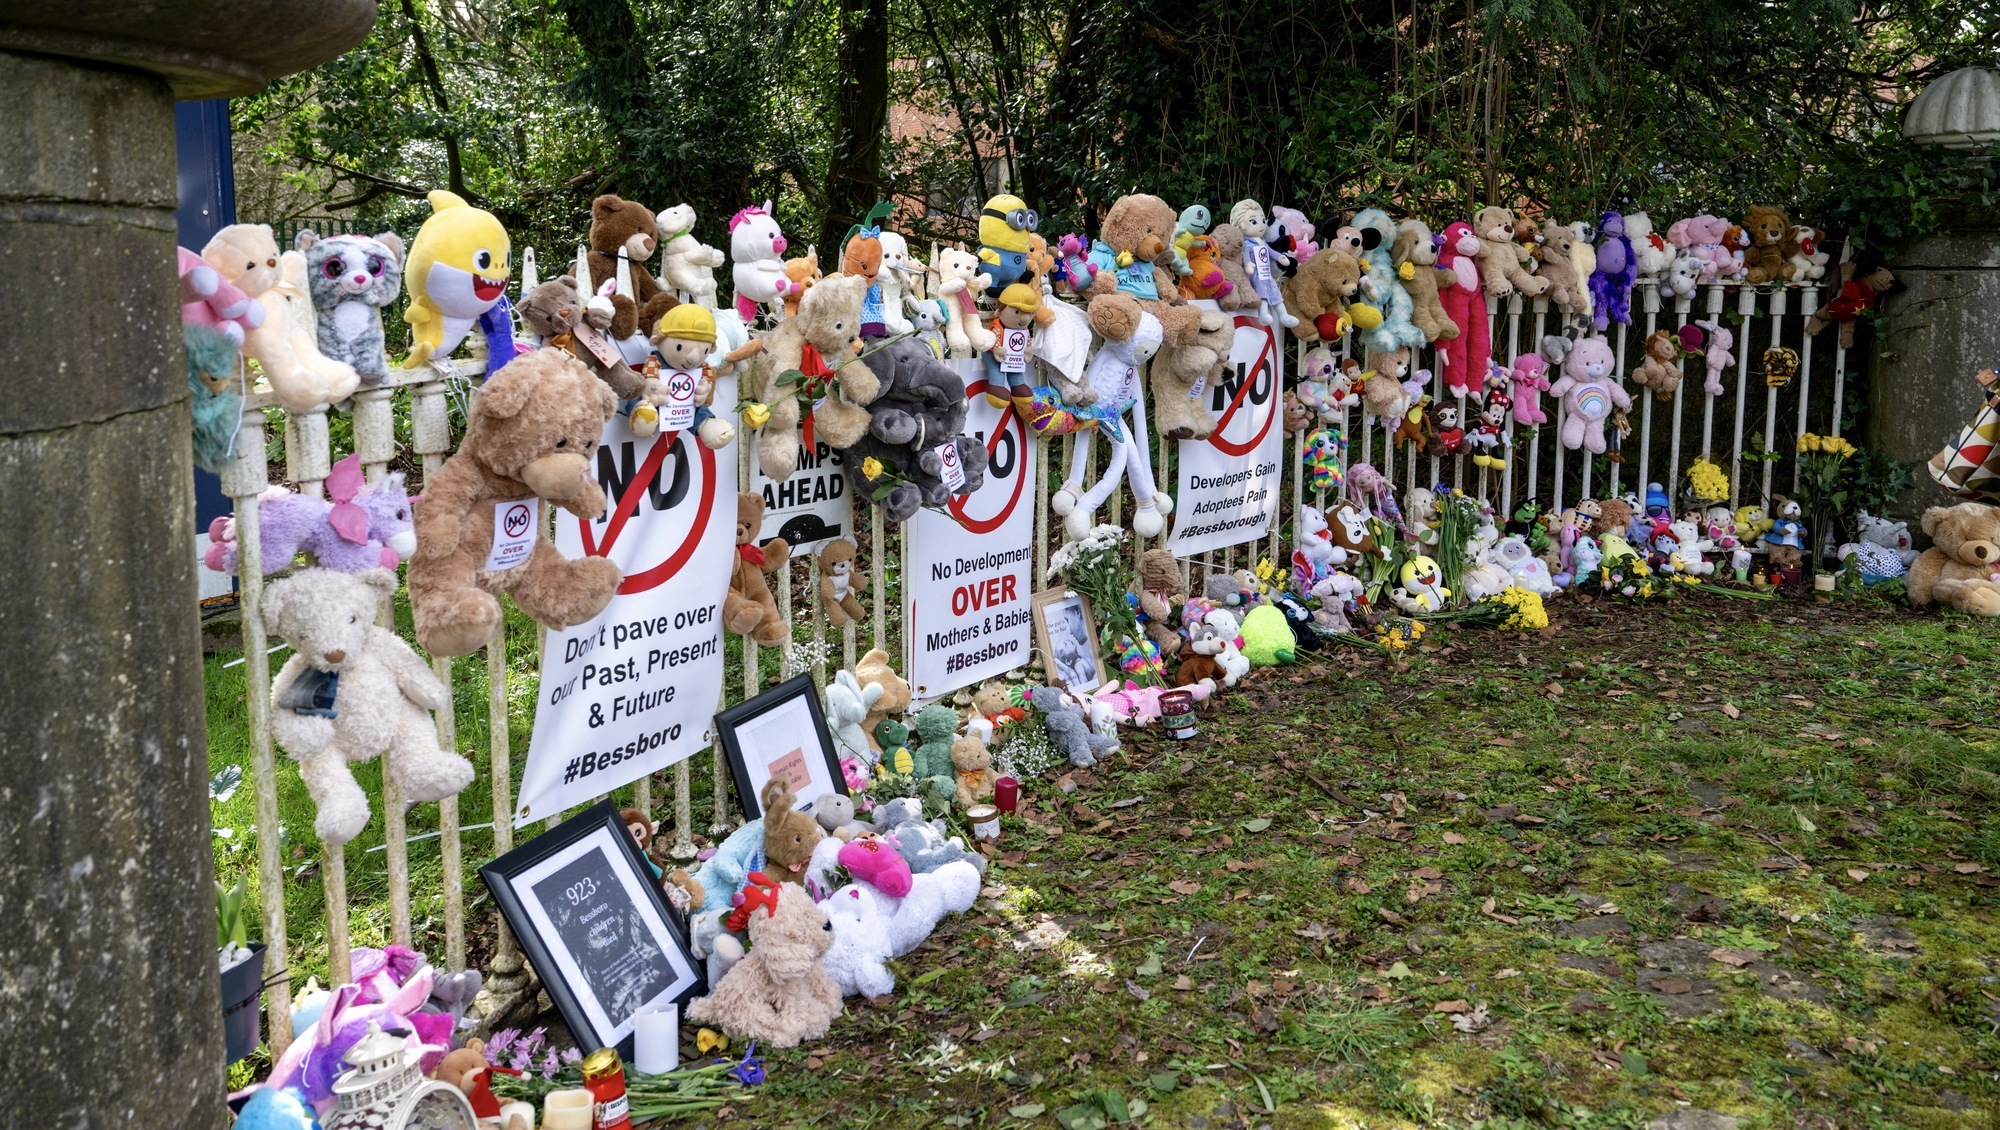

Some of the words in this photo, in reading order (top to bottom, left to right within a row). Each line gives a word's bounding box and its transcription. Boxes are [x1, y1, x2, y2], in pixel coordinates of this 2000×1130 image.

[671, 381, 691, 392] NO
[1212, 358, 1271, 411] NO
[671, 408, 690, 416] OVER
[597, 437, 691, 524] NO
[1191, 469, 1253, 490] Developers
[1255, 461, 1276, 478] Gain
[762, 473, 844, 511] AHEAD
[1192, 495, 1245, 516] Adoptees
[1247, 488, 1268, 504] Pain
[508, 515, 526, 527] NO
[1179, 511, 1267, 540] #Bessborough
[503, 546, 524, 554] OVER
[932, 562, 951, 581] No
[955, 543, 1032, 576] Development
[952, 574, 1017, 616] OVER
[565, 624, 605, 664] Don't
[613, 616, 668, 649] pave
[674, 604, 716, 629] over
[926, 624, 979, 652] Mothers
[983, 617, 992, 635] &
[995, 608, 1032, 632] Babies
[551, 676, 578, 705] our
[582, 656, 640, 690] Past,
[647, 634, 718, 674] Present
[946, 639, 1018, 675] #Bessboro
[588, 703, 605, 728] &
[612, 686, 675, 721] Future
[564, 723, 682, 785] #Bessboro
[566, 877, 597, 906] 923
[579, 902, 609, 925] Bessboro
[588, 915, 616, 937] children
[602, 931, 618, 947] died
